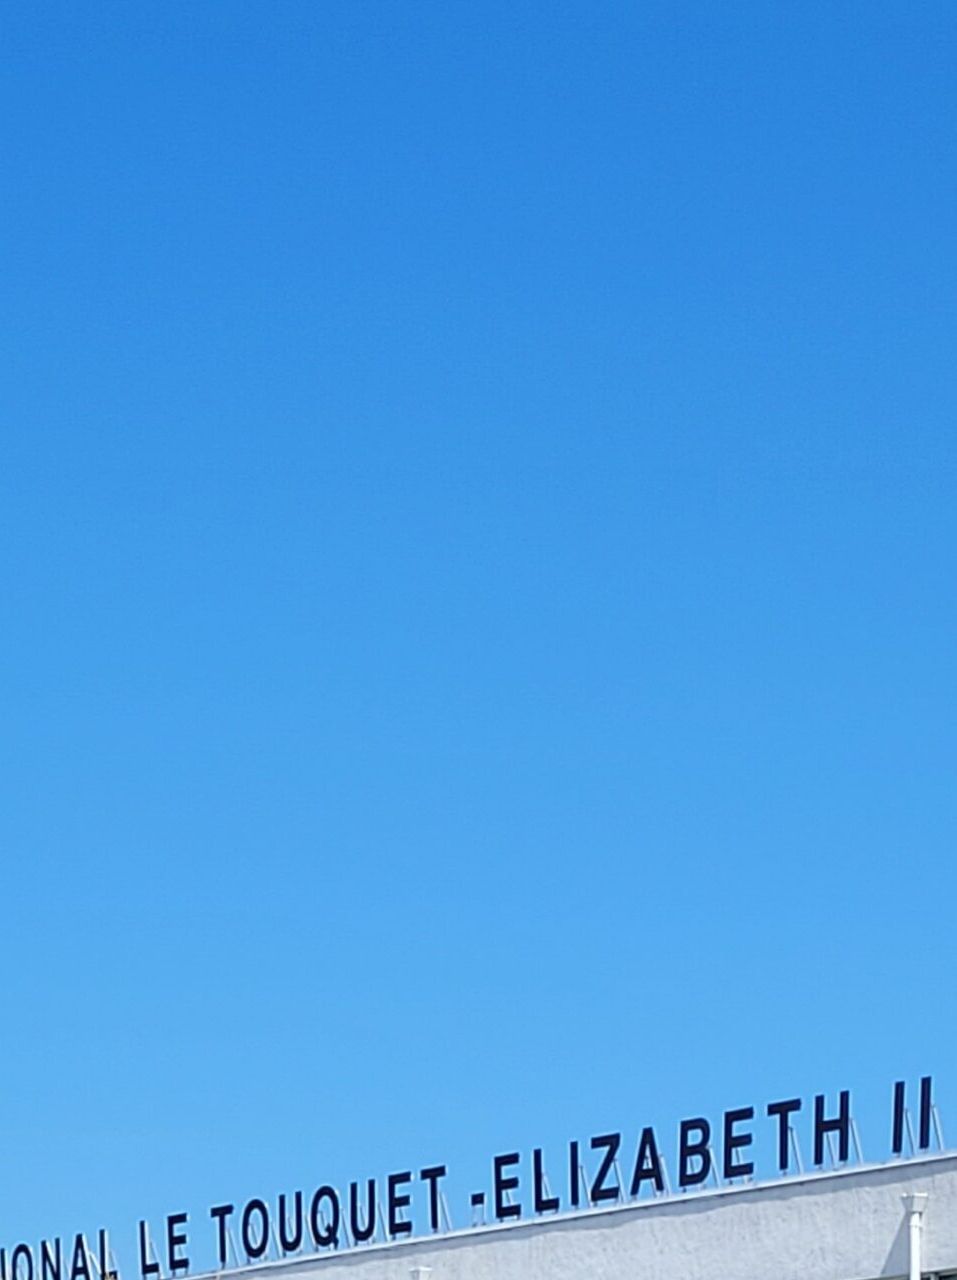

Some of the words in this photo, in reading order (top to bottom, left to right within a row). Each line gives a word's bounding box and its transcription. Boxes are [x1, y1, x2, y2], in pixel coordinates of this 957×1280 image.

[139, 1212, 190, 1276] LE
[210, 1165, 446, 1263] TOUQUET
[892, 1076, 932, 1154] II
